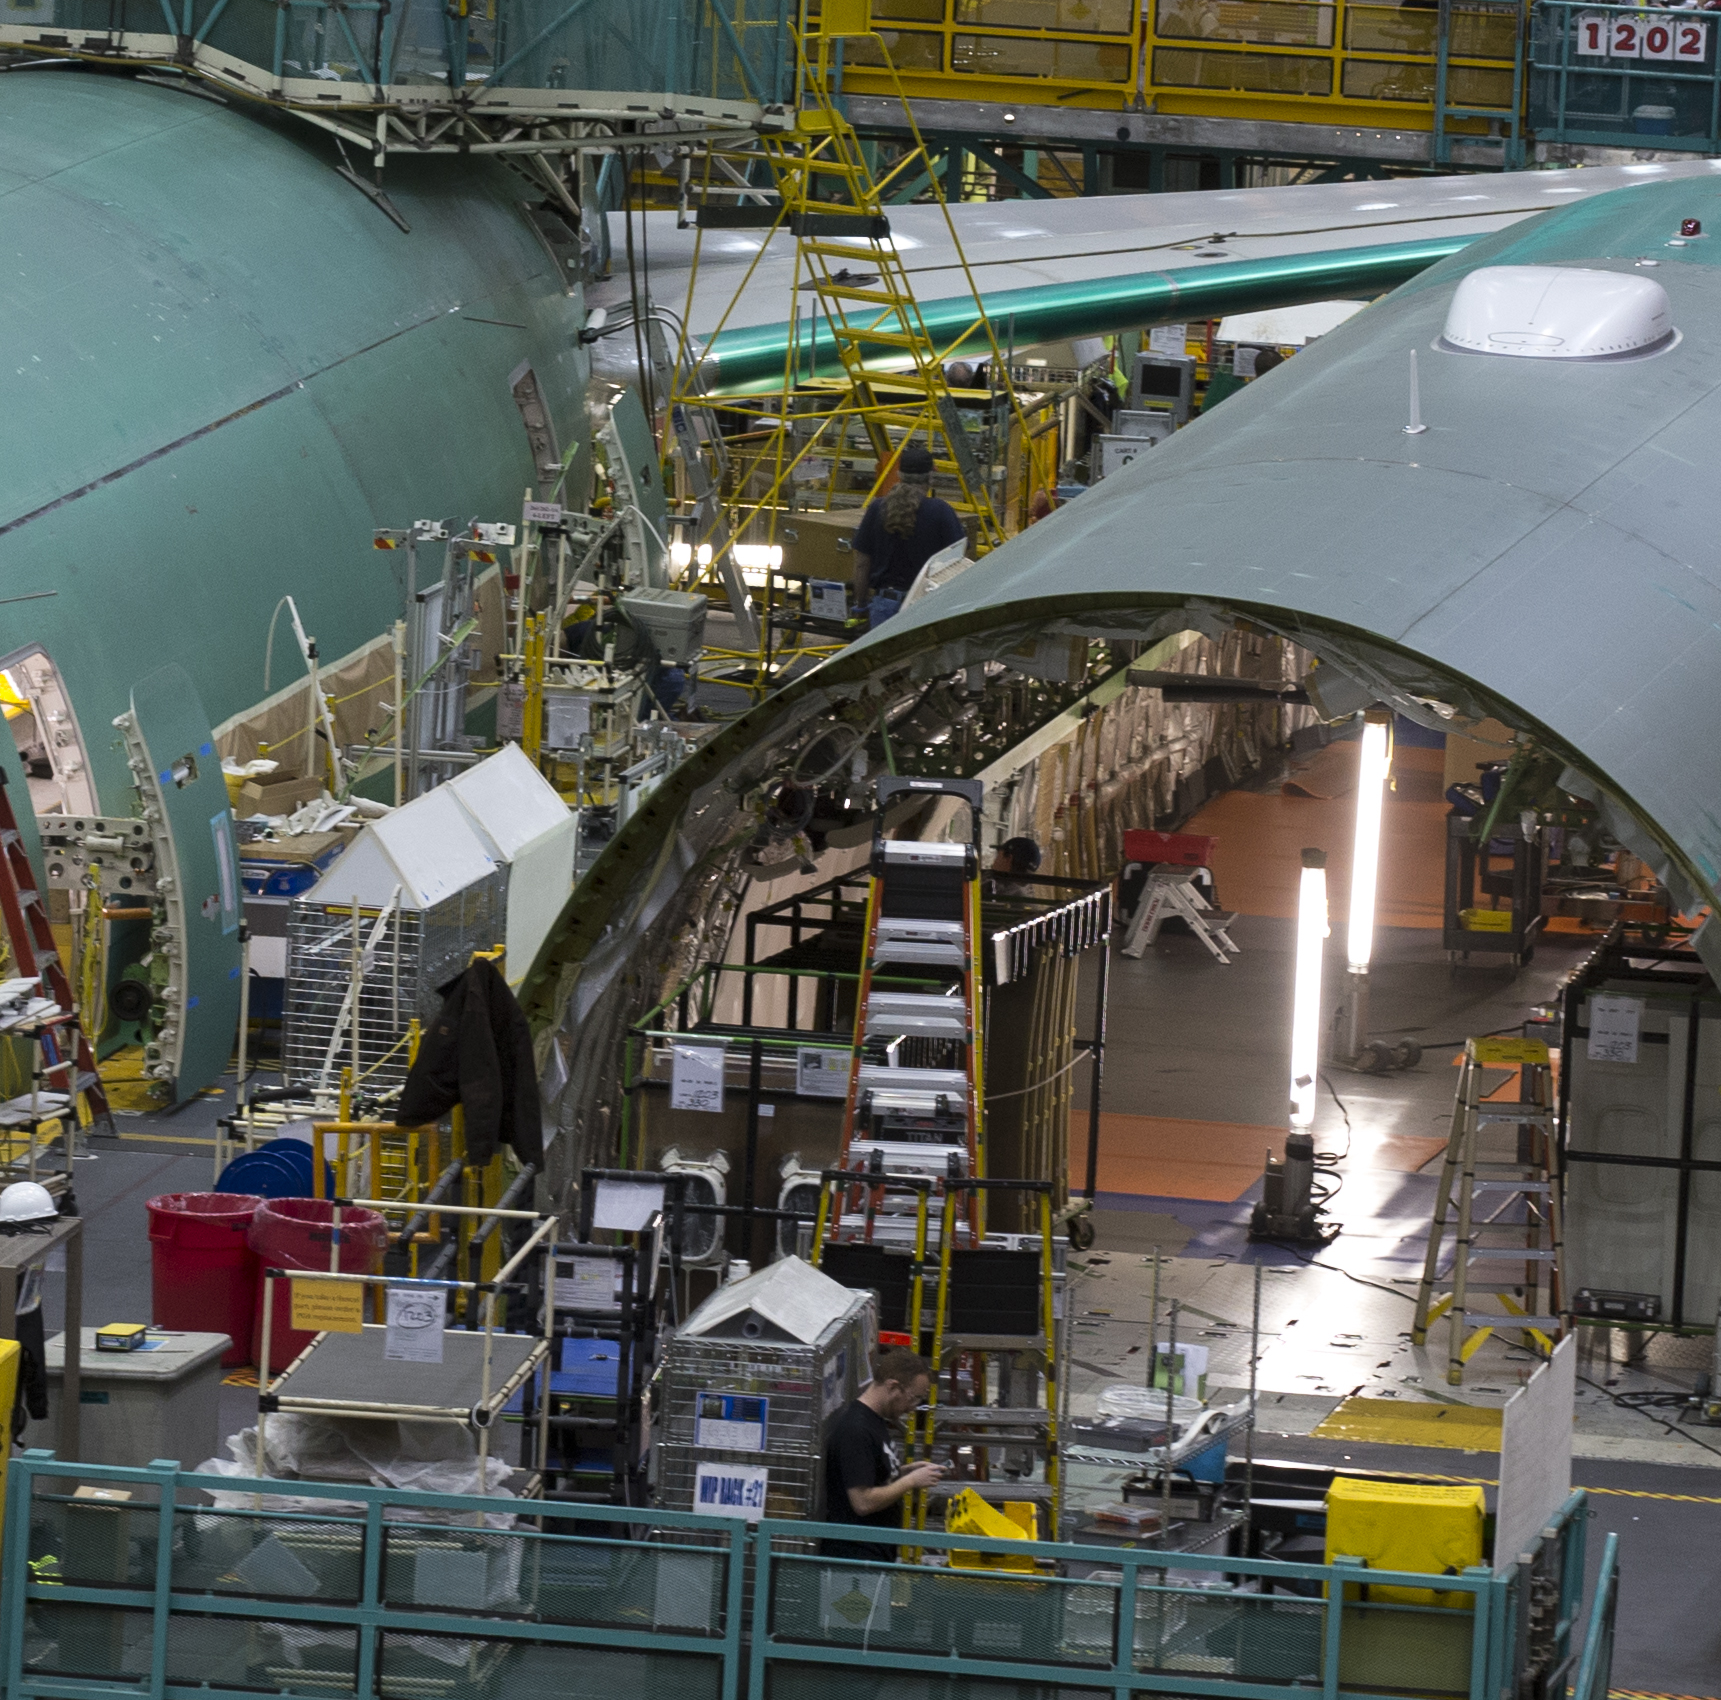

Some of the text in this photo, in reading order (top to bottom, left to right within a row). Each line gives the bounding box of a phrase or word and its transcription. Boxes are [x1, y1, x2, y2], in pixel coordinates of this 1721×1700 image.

[1585, 22, 1702, 56] 1202
[1114, 447, 1131, 455] CART
[906, 1131, 943, 1142] TITAN
[719, 1477, 745, 1506] RACK
